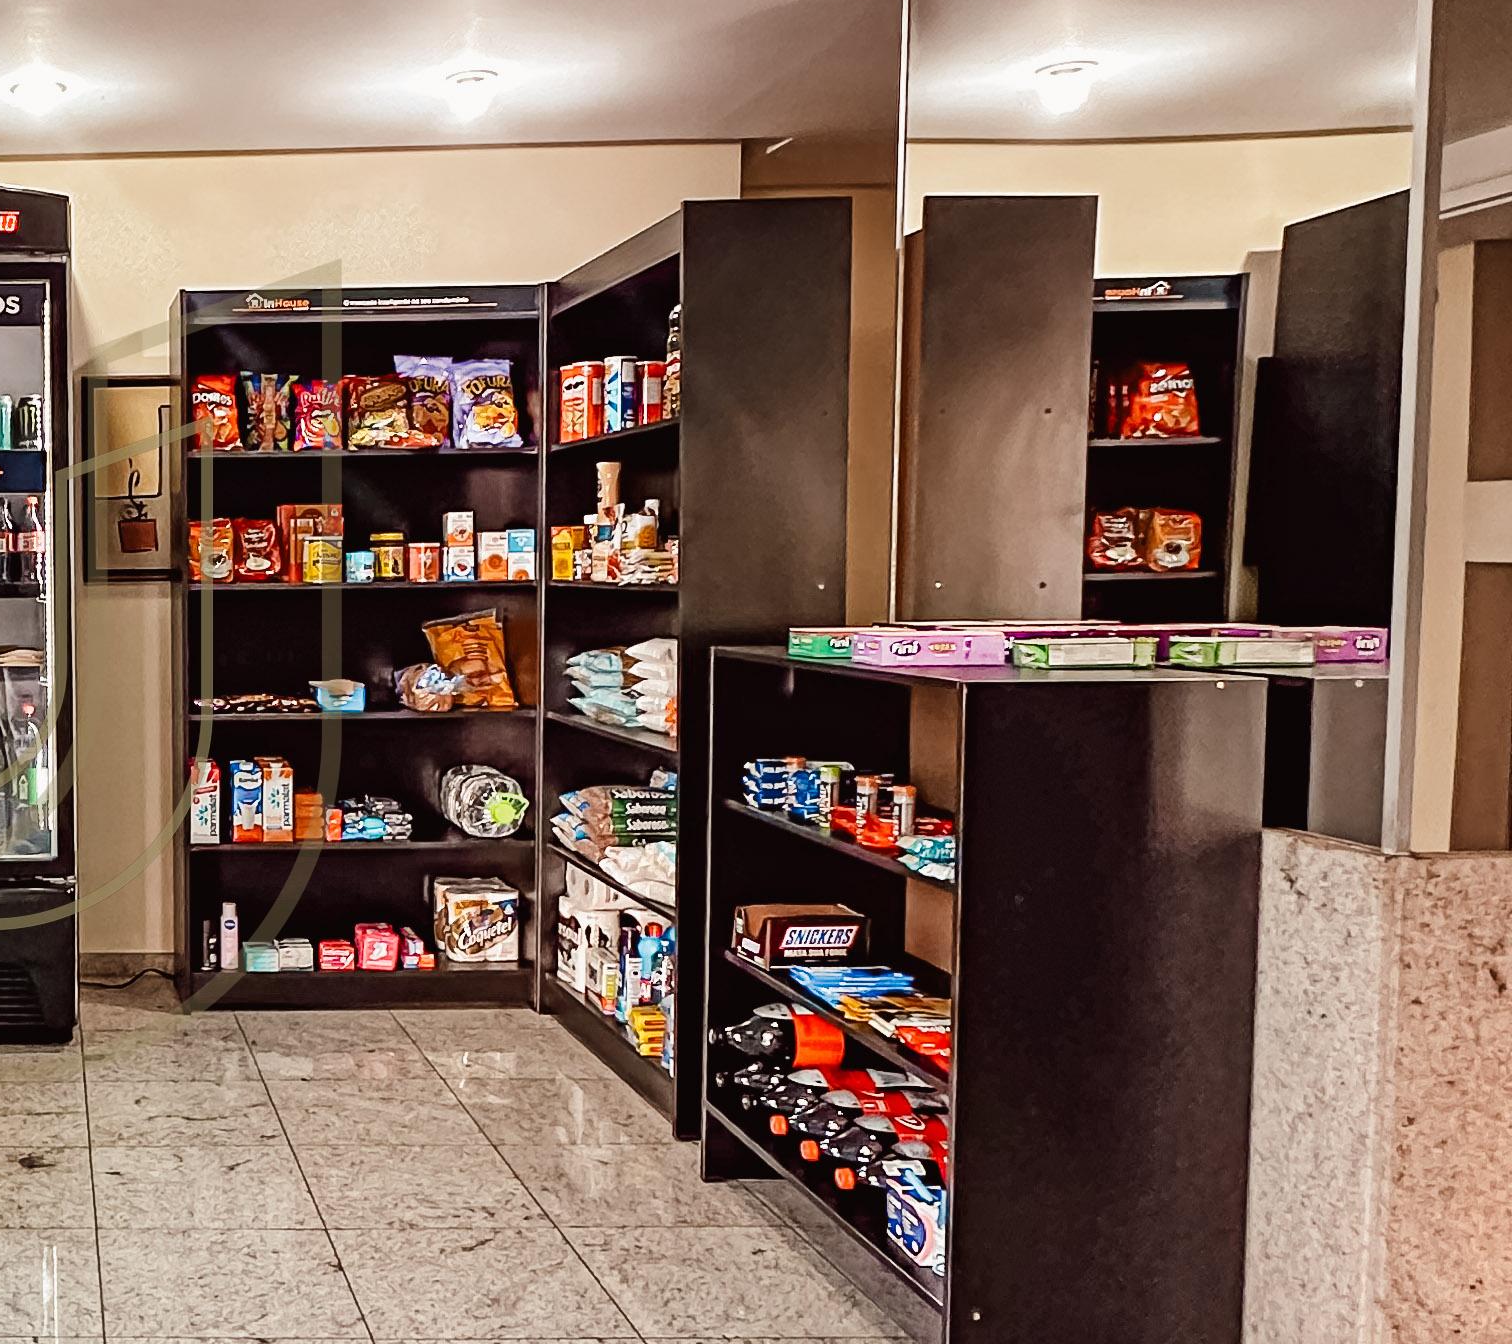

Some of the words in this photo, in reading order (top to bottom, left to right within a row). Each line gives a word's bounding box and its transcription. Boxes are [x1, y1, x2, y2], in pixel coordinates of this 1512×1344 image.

[408, 375, 450, 393] OFURA
[457, 916, 512, 950] Coquetel
[785, 929, 854, 946] SNICKERS
